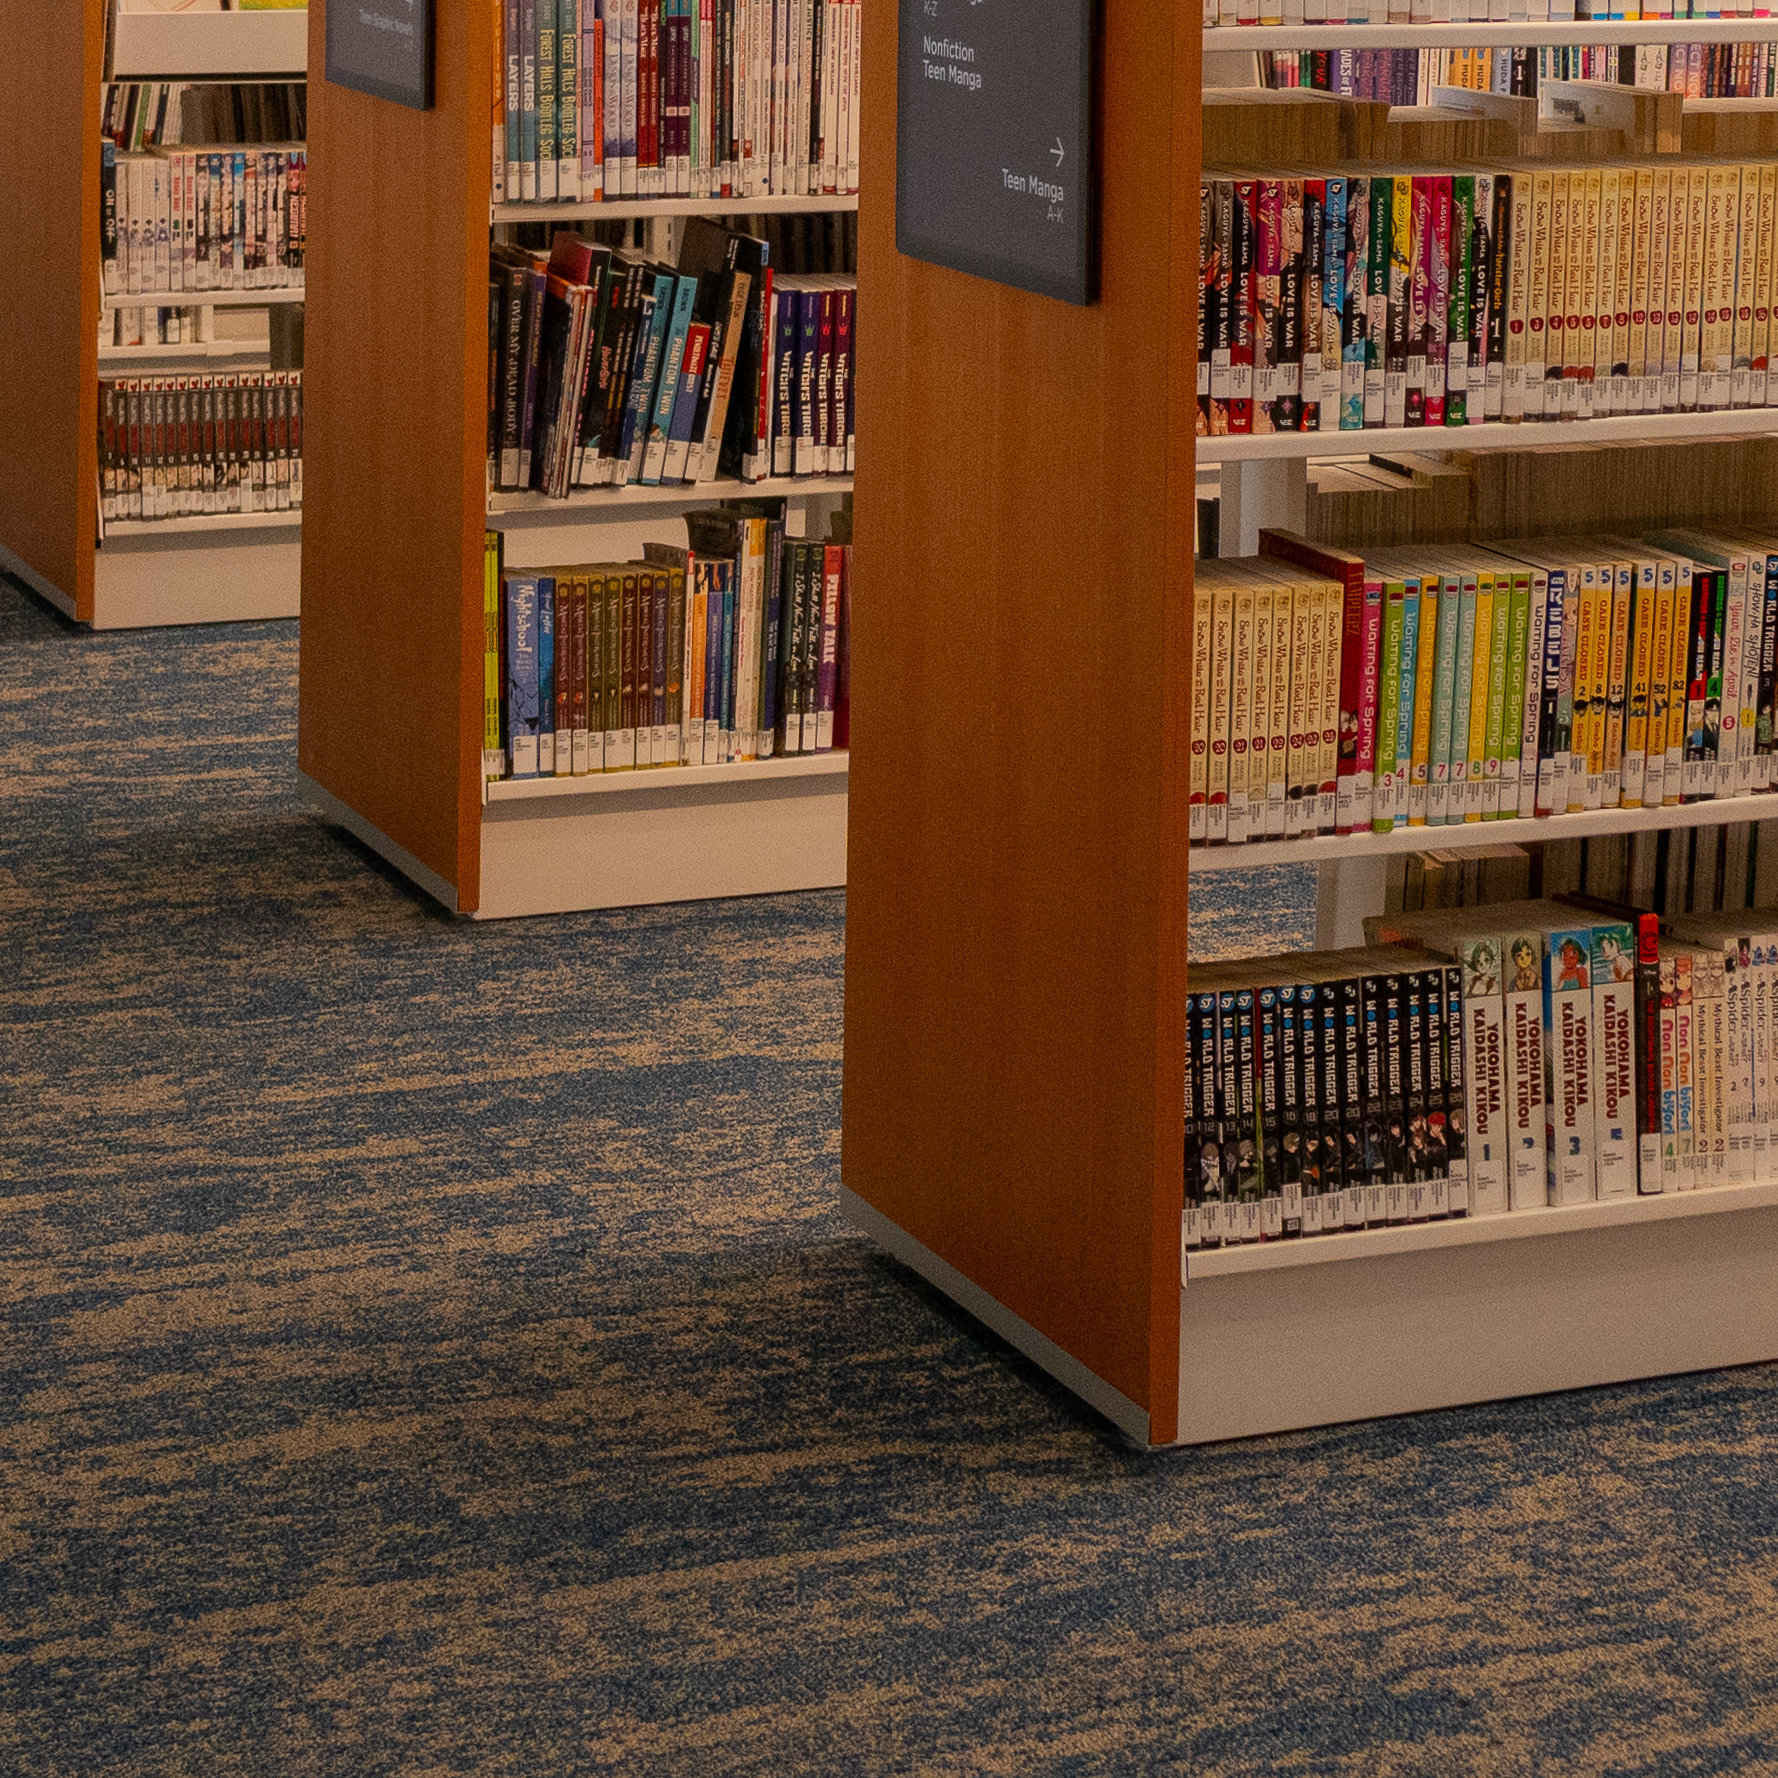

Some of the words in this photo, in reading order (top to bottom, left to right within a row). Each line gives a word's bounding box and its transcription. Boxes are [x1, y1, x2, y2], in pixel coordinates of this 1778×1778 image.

[923, 0, 938, 17] K-Z
[540, 29, 555, 63] FOREST
[923, 35, 974, 62] Nonfiction
[508, 55, 519, 112] LAYERS
[539, 65, 554, 91] HILLS
[923, 60, 946, 81] Teen
[948, 65, 982, 90] Manga
[539, 95, 554, 135] BOOTLEG
[1002, 168, 1026, 192] Teen
[1028, 174, 1064, 203] Manga
[1046, 205, 1064, 223] A-K
[1220, 274, 1228, 296] LOVE
[510, 299, 522, 334] OVER
[1220, 303, 1227, 318] IS
[509, 335, 520, 355] MY
[1218, 326, 1227, 349] WAR
[665, 338, 682, 386] PHANTOM
[659, 389, 673, 415] TWIN
[824, 573, 839, 626] PILLOW
[513, 584, 535, 653] Nightschool
[1582, 601, 1591, 632] CASE
[822, 629, 836, 664] TALK
[1580, 634, 1590, 681] CLOSED
[1743, 633, 1760, 679] SHOTEN!
[1579, 686, 1586, 697] 2
[1595, 683, 1603, 694] 8
[1611, 684, 1623, 696] 12
[1634, 682, 1646, 693] 41
[1396, 768, 1405, 780] 4
[1473, 1008, 1488, 1083] KAIDASHI
[1486, 1022, 1501, 1114] YOKOHAMA
[1202, 1068, 1215, 1118] TRIGGER
[1476, 1086, 1489, 1135] KIKOU
[1569, 1136, 1581, 1155] 3
[1698, 1139, 1708, 1152] 2
